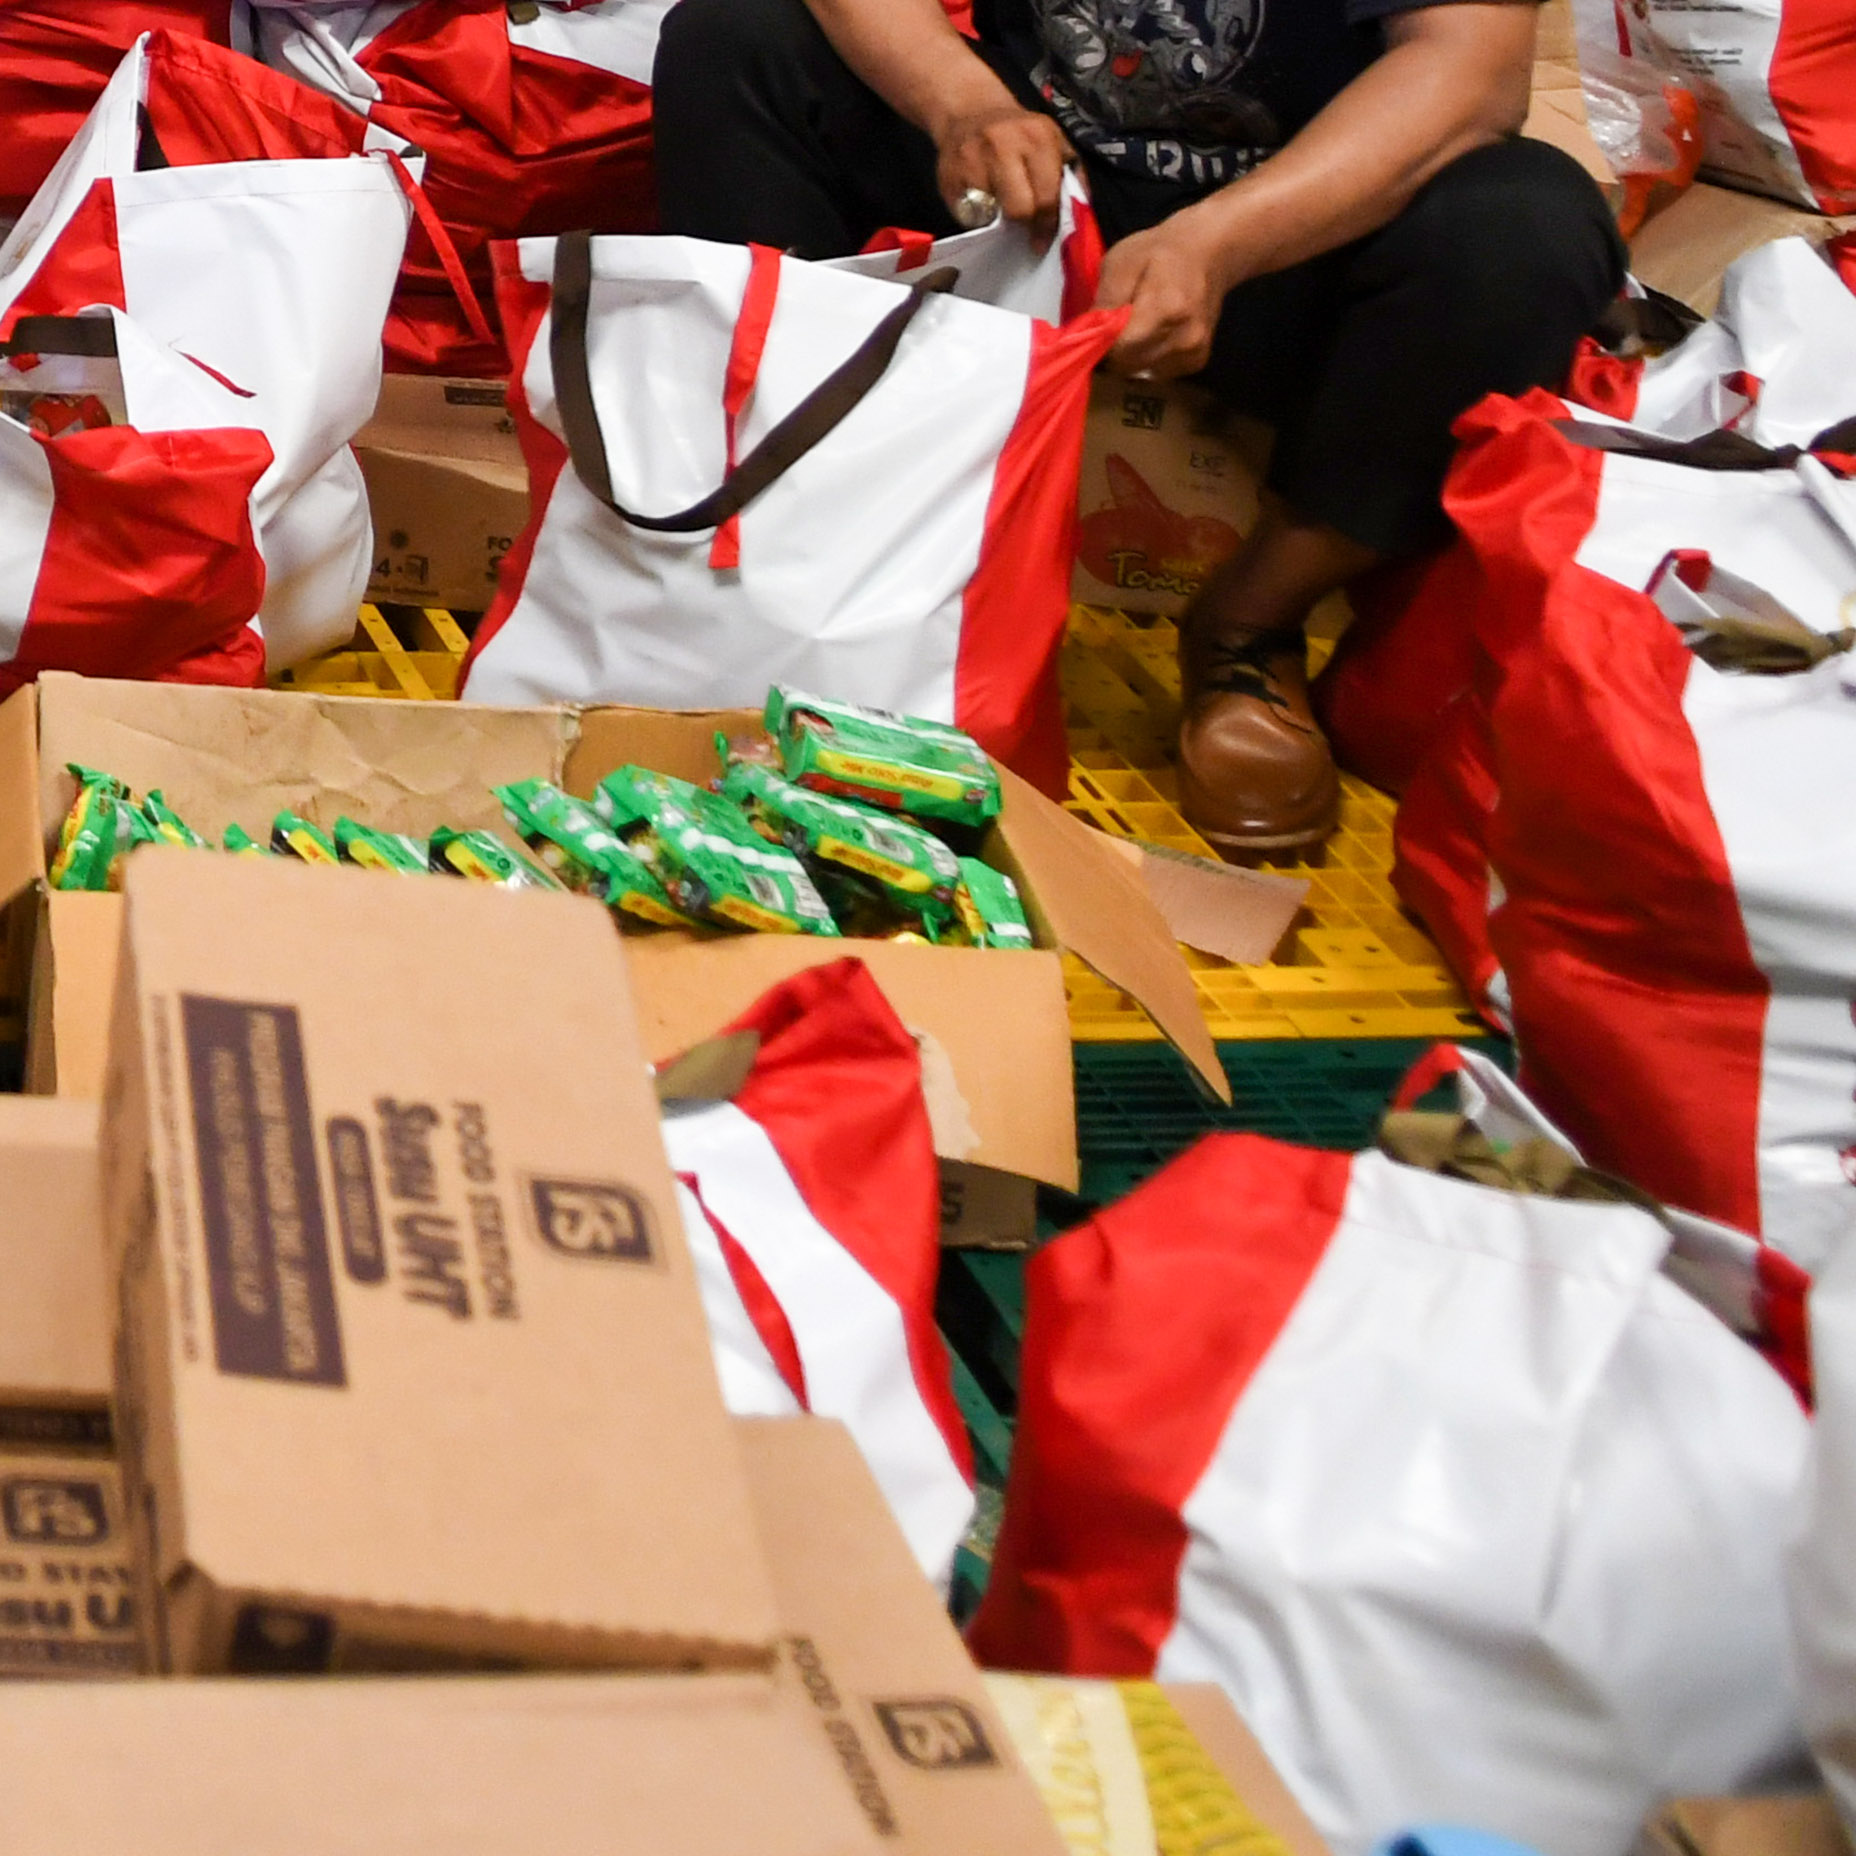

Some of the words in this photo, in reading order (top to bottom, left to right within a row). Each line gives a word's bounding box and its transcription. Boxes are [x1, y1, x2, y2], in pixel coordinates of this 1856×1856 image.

[1122, 394, 1165, 431] SNI
[487, 536, 513, 551] FO
[374, 1095, 441, 1204] Susu
[453, 1099, 496, 1184] FOOD
[392, 1211, 475, 1321] UHT
[466, 1193, 521, 1323] STATION
[279, 1264, 320, 1374] JAKARTA
[43, 1562, 132, 1584] STAT
[792, 1634, 844, 1713] FOOD
[823, 1718, 901, 1839] STATION
